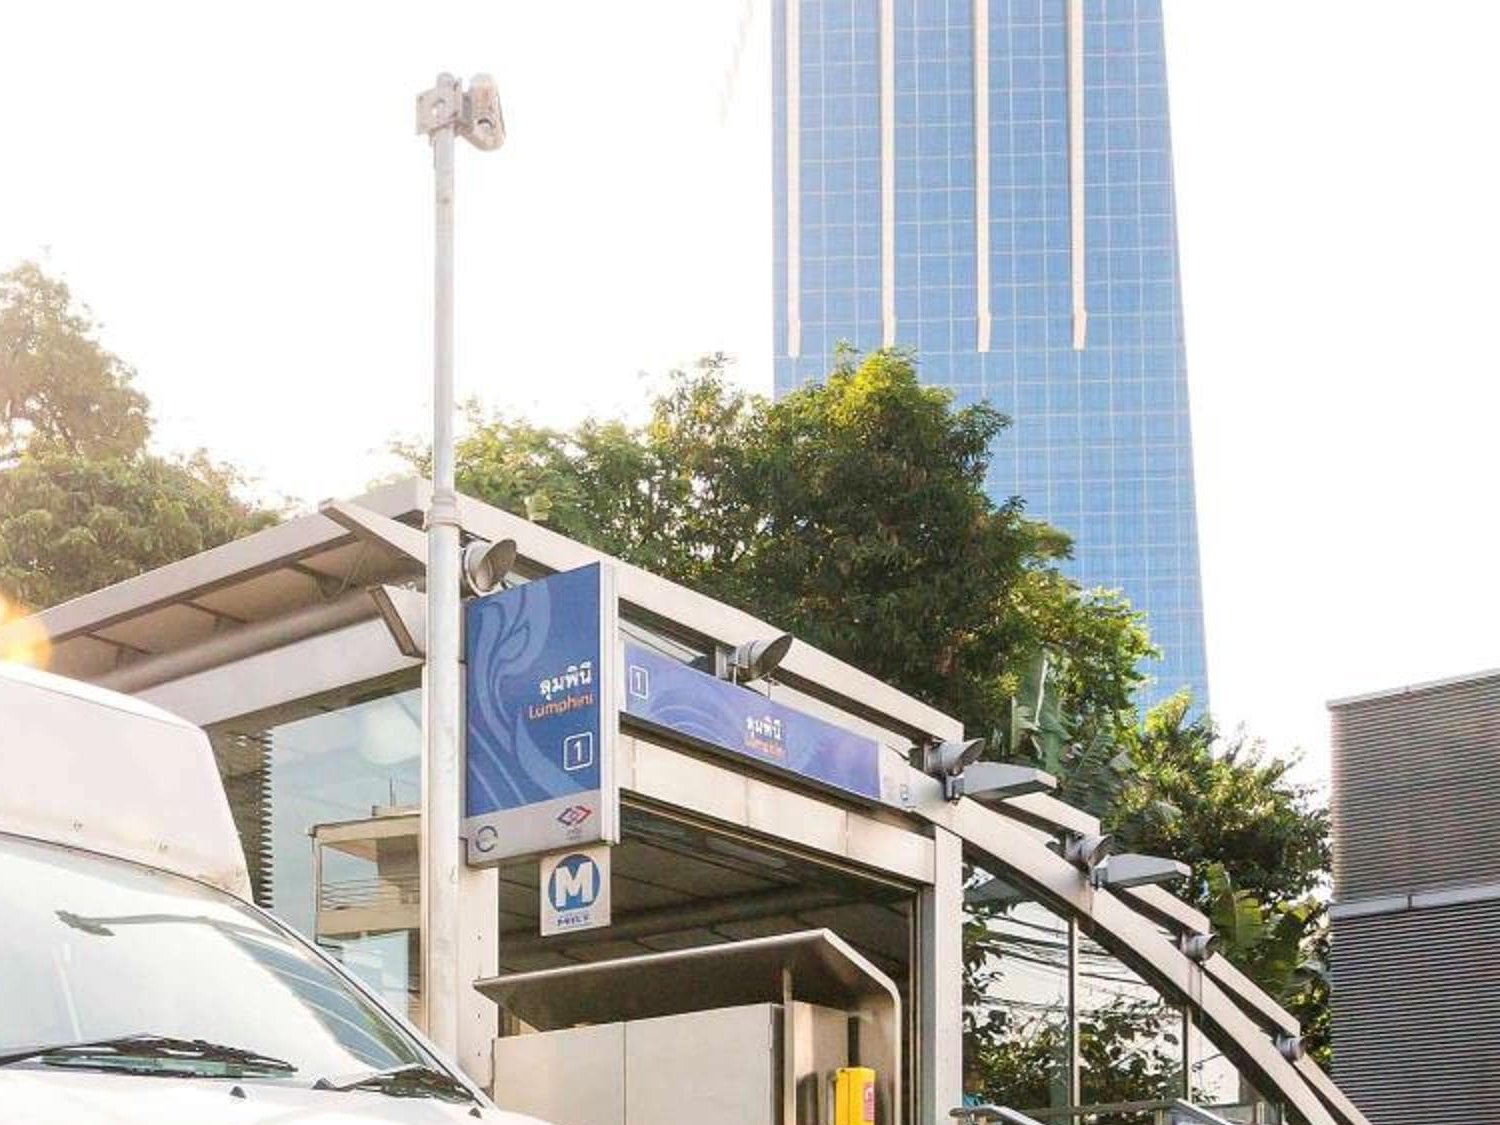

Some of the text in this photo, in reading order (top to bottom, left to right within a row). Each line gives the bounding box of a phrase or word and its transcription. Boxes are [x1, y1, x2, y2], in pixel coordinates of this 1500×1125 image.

[540, 661, 592, 700] ลุมพินี
[555, 861, 593, 907] M
